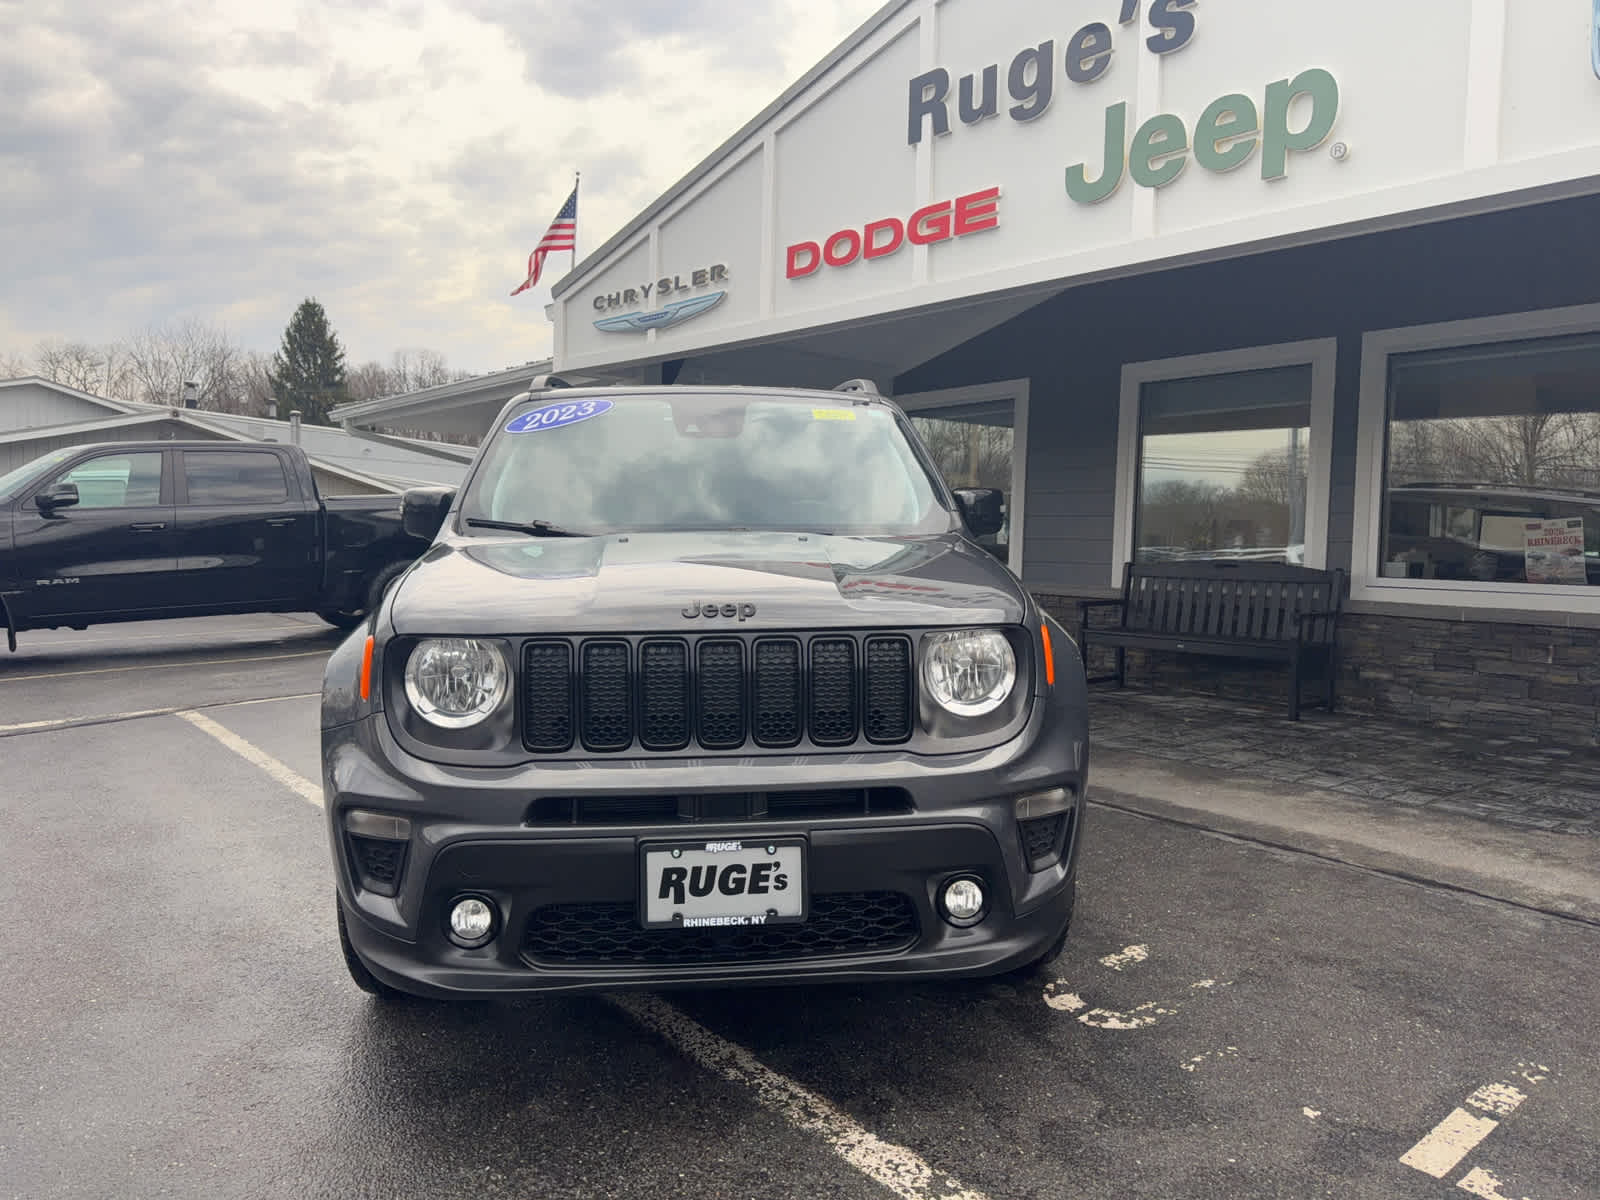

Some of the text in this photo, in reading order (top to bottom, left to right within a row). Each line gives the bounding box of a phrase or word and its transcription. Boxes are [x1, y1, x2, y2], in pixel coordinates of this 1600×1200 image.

[908, 0, 1197, 145] Ruge's
[1065, 68, 1340, 204] Jeep
[786, 186, 1000, 280] DODGE
[593, 263, 728, 311] CHRYSLER
[524, 400, 596, 431] 2023
[681, 600, 757, 622] Jeep
[658, 861, 788, 904] RUGE's
[683, 915, 767, 928] RHINEBECK, NY
